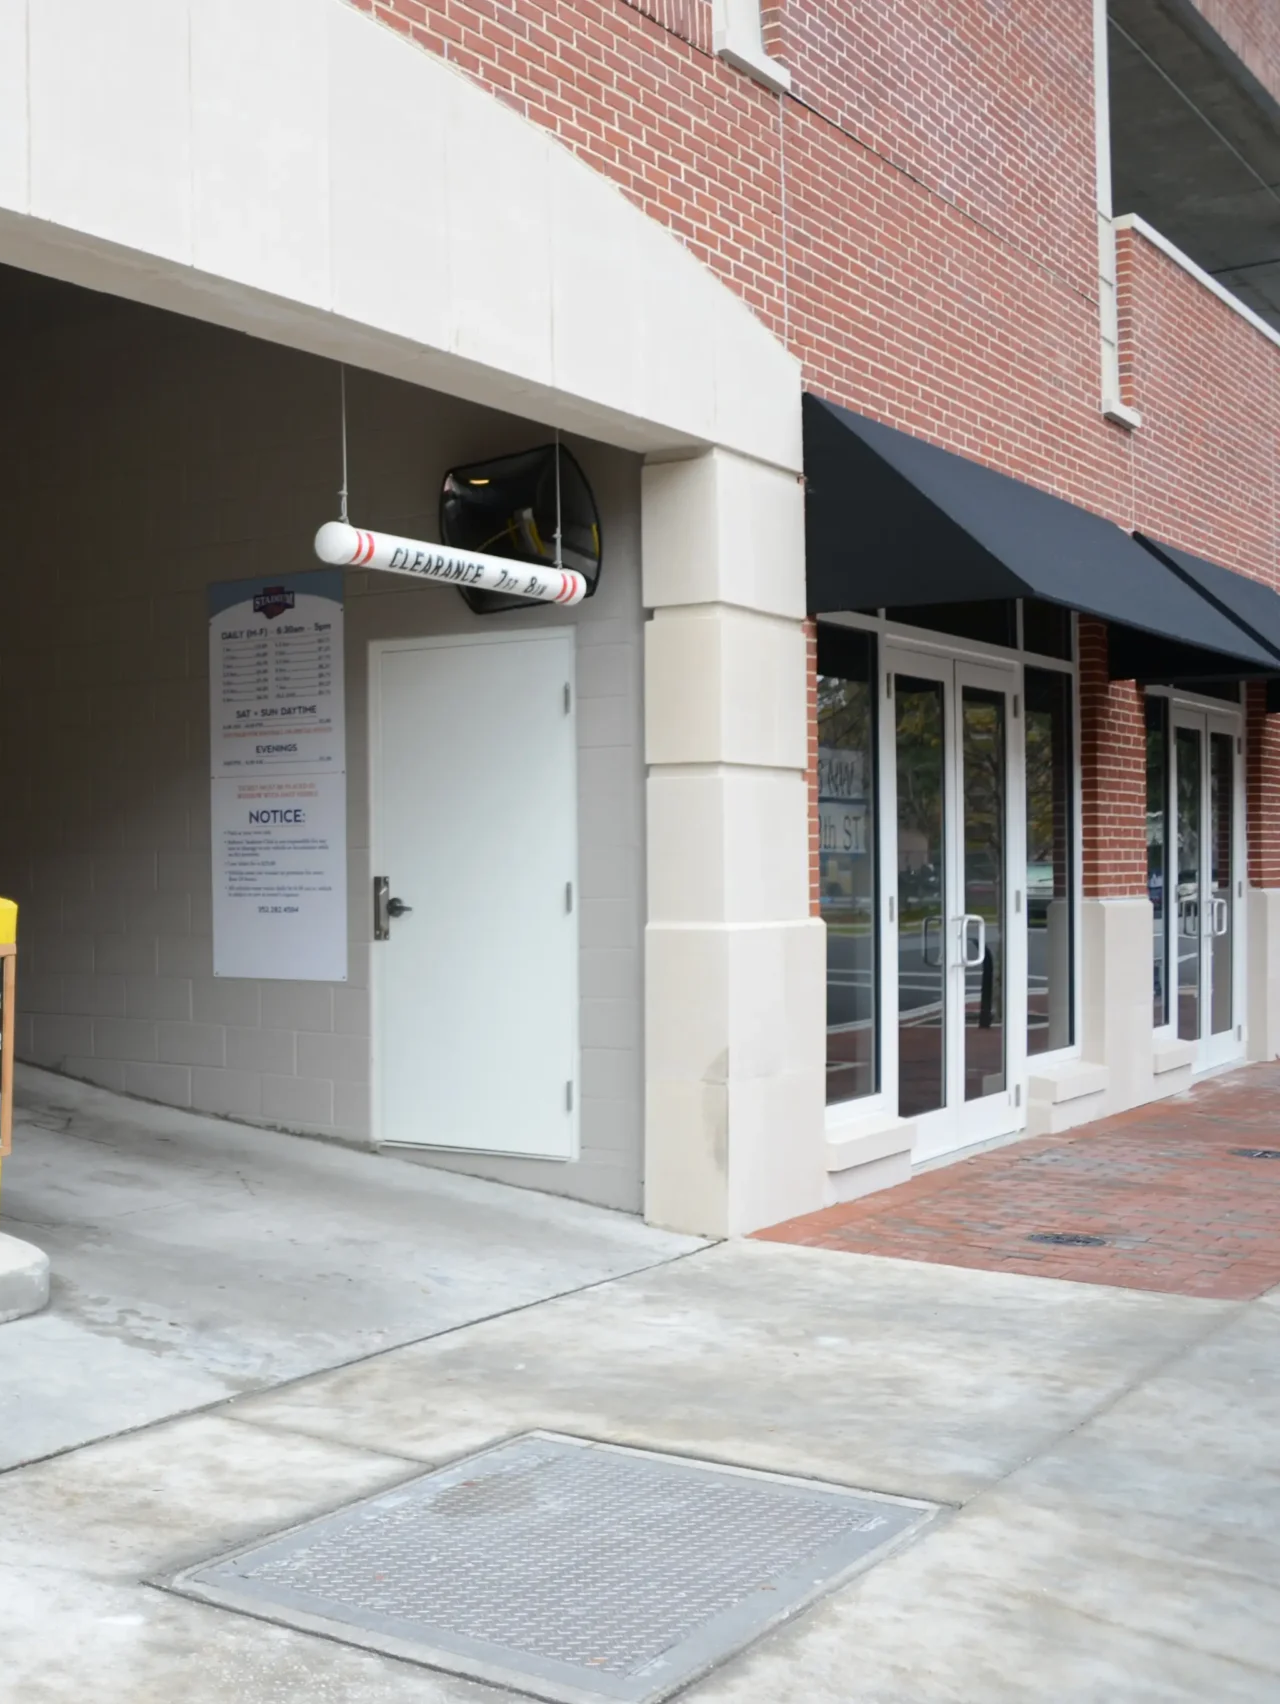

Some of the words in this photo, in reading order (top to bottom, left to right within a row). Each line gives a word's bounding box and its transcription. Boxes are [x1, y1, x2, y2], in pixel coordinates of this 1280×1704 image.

[388, 547, 485, 584] CLEARANCE
[221, 631, 244, 640] DAILY
[235, 709, 252, 719] SAT
[260, 707, 278, 718] SUN
[280, 705, 317, 716] DAYTIME
[255, 743, 298, 754] EVENINGS
[248, 808, 306, 825] NOTICE:
